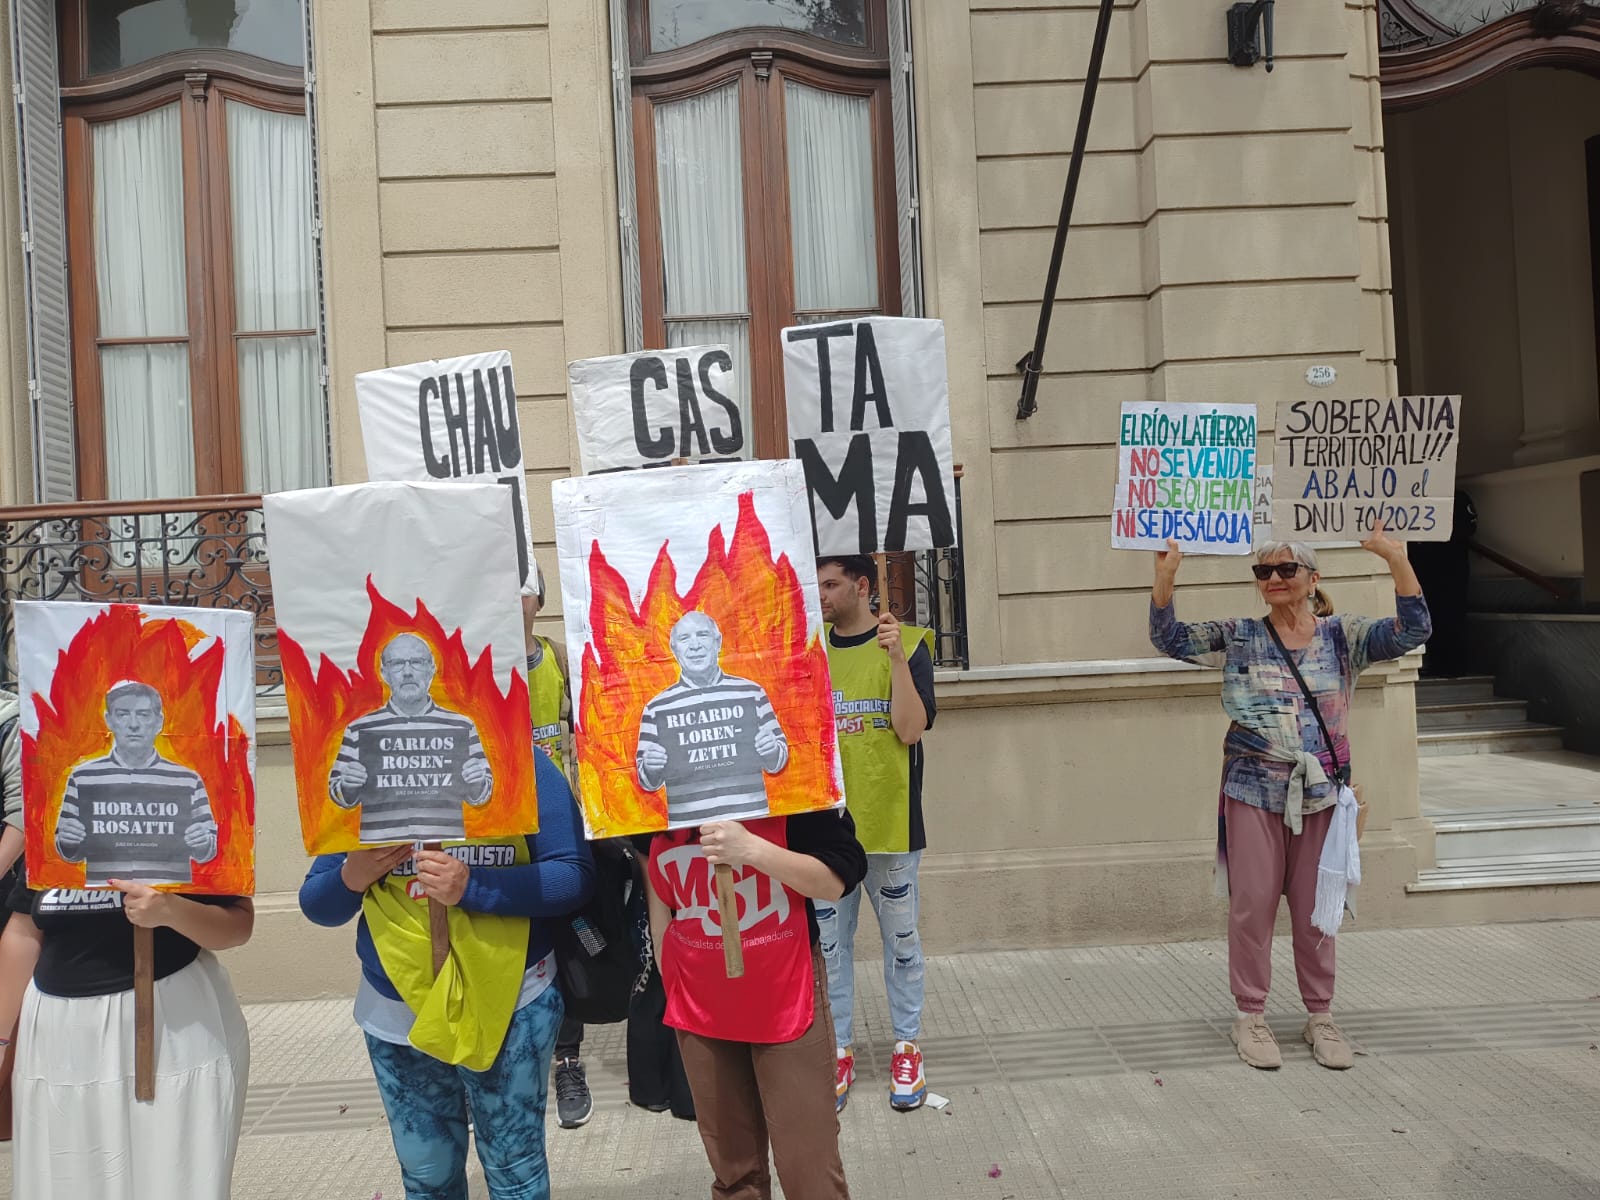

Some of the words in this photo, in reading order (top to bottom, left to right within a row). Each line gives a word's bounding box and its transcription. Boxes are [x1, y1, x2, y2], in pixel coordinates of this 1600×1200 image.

[787, 322, 894, 432] TA
[1312, 367, 1331, 379] 256
[629, 350, 744, 459] CAS
[1286, 396, 1455, 434] SOBERANIA
[419, 365, 521, 478] CHAU
[1130, 448, 1160, 477] NO
[1160, 448, 1184, 478] SE
[1187, 447, 1255, 479] VENDE
[1280, 432, 1453, 467] TERRITORIAL!!!
[795, 431, 955, 556] MA
[1128, 479, 1156, 508] NO
[1156, 479, 1182, 508] SE
[1184, 478, 1252, 512] QUEMA
[1302, 466, 1397, 499] ABAJO
[1411, 469, 1430, 497] el
[1137, 509, 1158, 538] SE
[1162, 509, 1251, 544] DESALOJA
[1294, 502, 1344, 533] DNU
[1354, 501, 1436, 532] 70/2023
[666, 705, 744, 729] RICARDO
[379, 736, 454, 751] CARLOS
[678, 725, 742, 746] LOREN-
[382, 755, 452, 769] ROSEN-
[688, 743, 738, 763] ZETTI
[376, 773, 453, 787] KRANTZ
[92, 801, 179, 816] HORACIO
[92, 820, 175, 834] ROSATTI
[741, 929, 794, 948] Trabajadores
